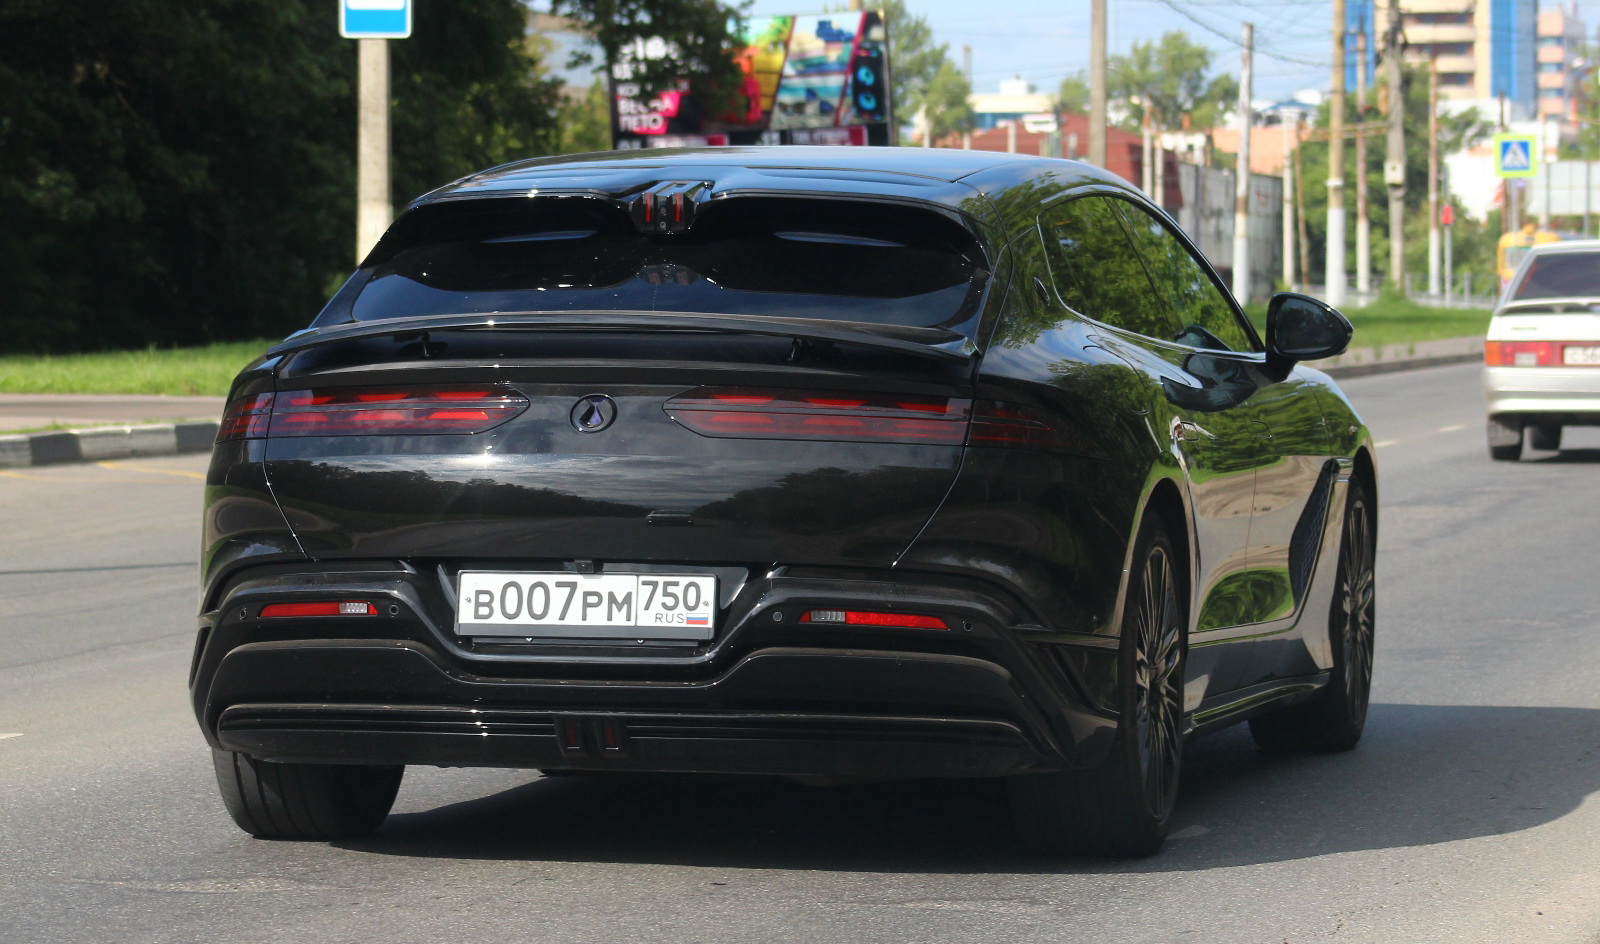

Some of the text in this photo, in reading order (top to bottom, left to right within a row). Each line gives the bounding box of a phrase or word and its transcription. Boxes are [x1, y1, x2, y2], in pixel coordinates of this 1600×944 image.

[474, 580, 701, 621] В007РМ 750
[654, 613, 685, 624] RUS
